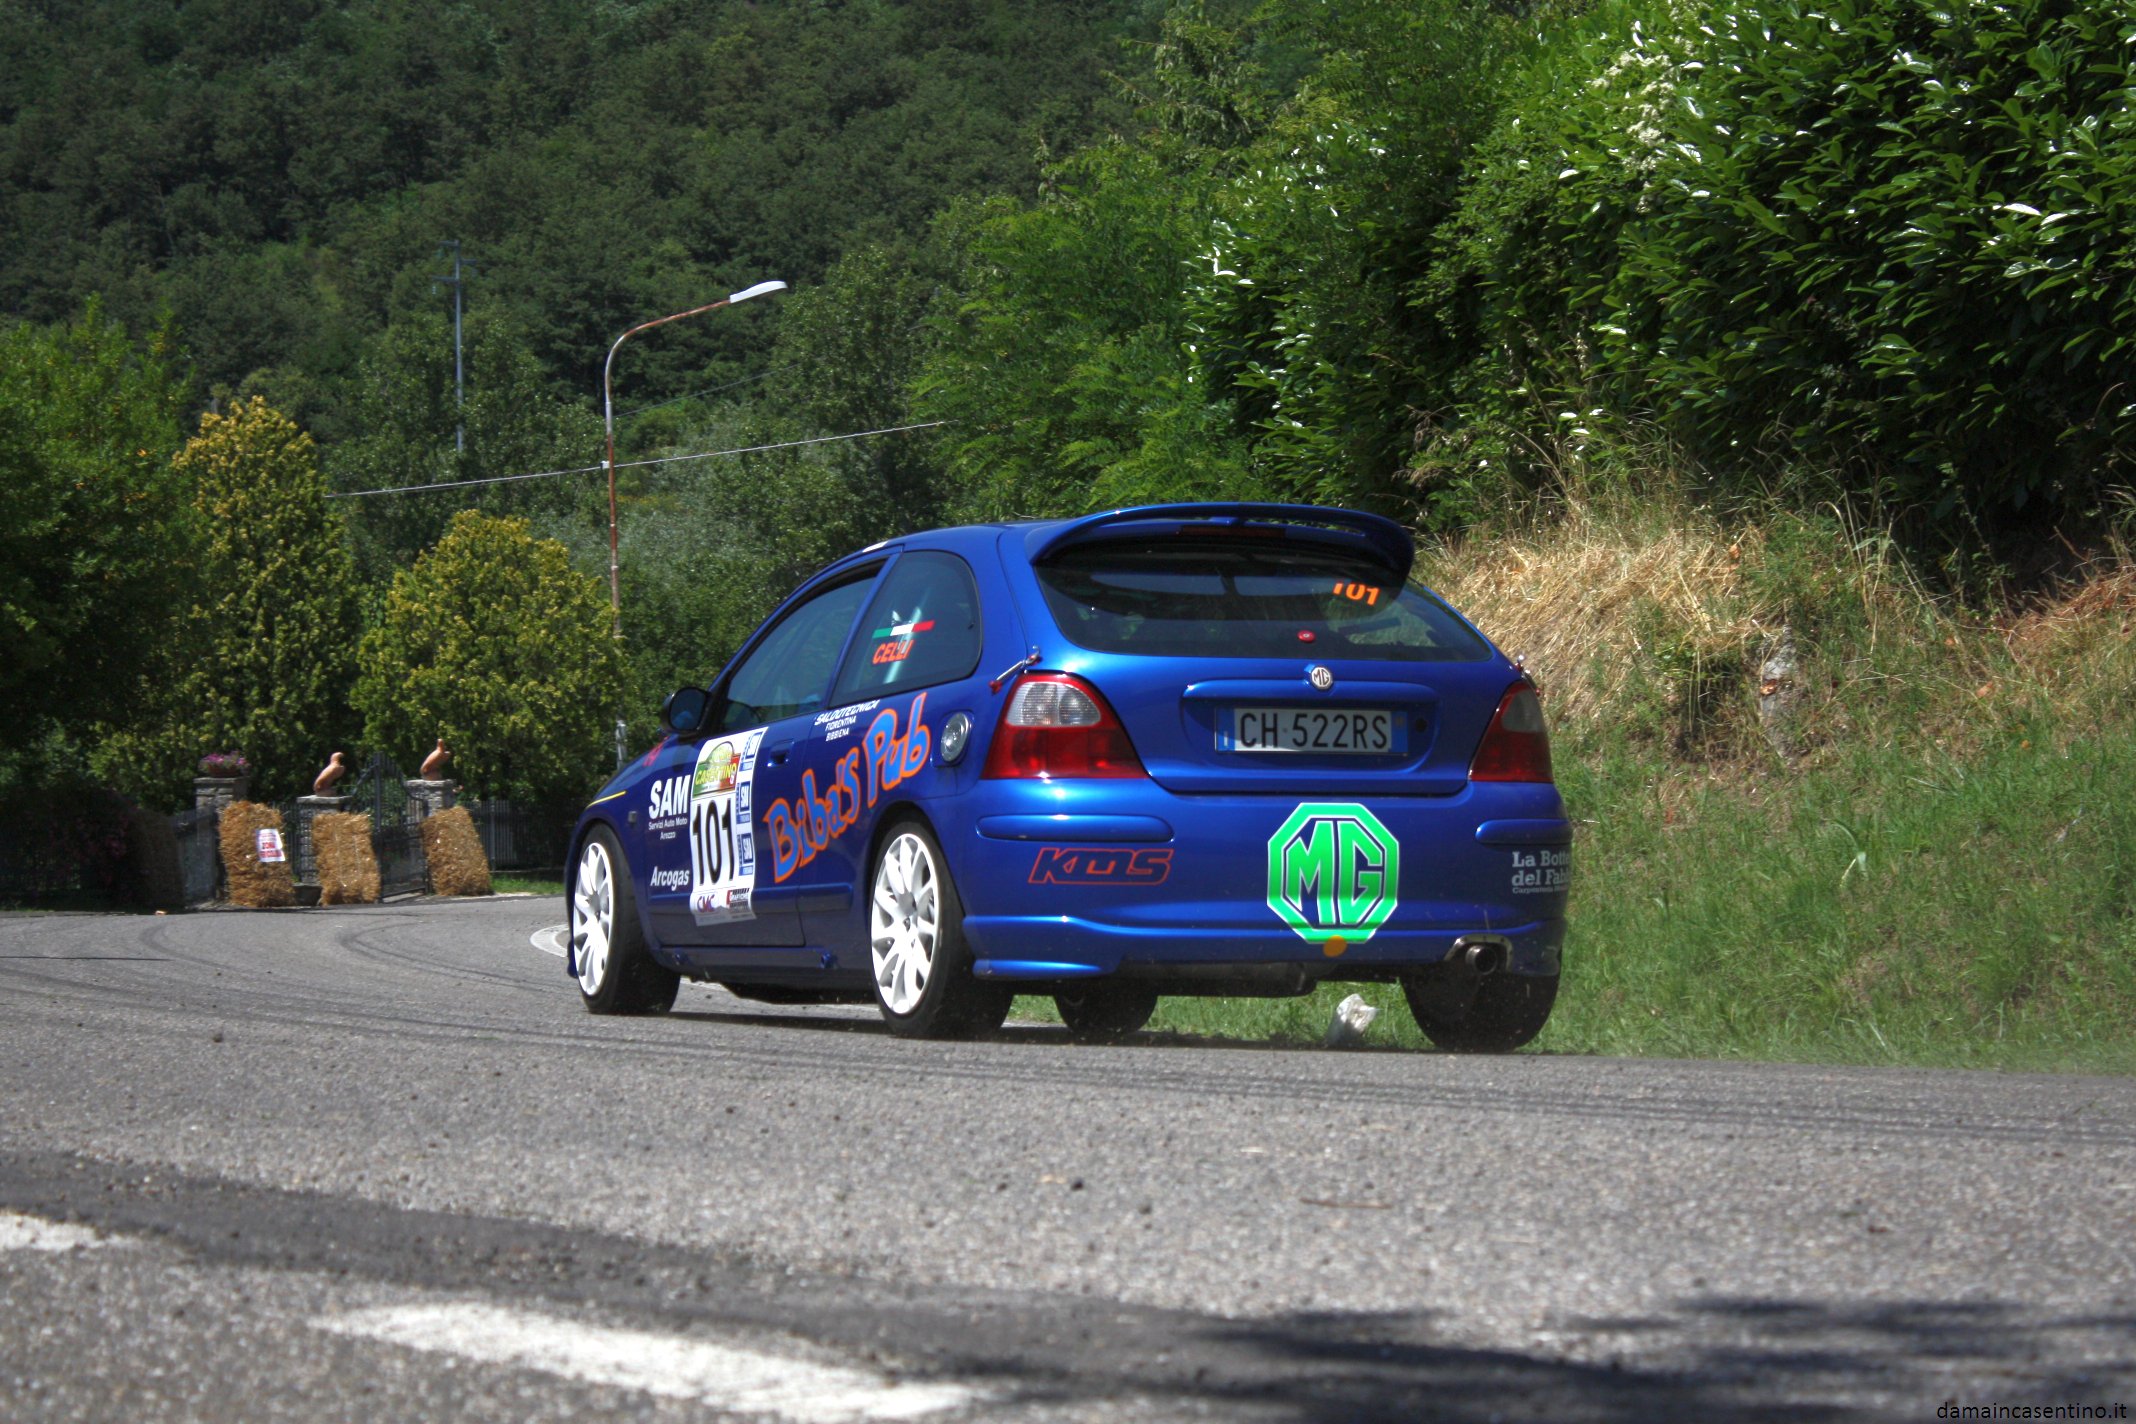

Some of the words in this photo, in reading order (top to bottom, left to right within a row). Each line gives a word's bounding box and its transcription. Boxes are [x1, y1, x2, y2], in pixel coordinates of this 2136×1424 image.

[1312, 668, 1331, 687] MG
[1239, 713, 1278, 749] CH
[1291, 713, 1389, 750] 522RS
[862, 692, 932, 809] Pub
[648, 774, 691, 820] SAM
[664, 818, 676, 828] Auto
[676, 816, 688, 826] Moto
[692, 797, 736, 887] 101
[1282, 817, 1387, 928] MG
[1511, 851, 1537, 868] La
[649, 866, 691, 891] Arcogas
[1511, 869, 1541, 887] del
